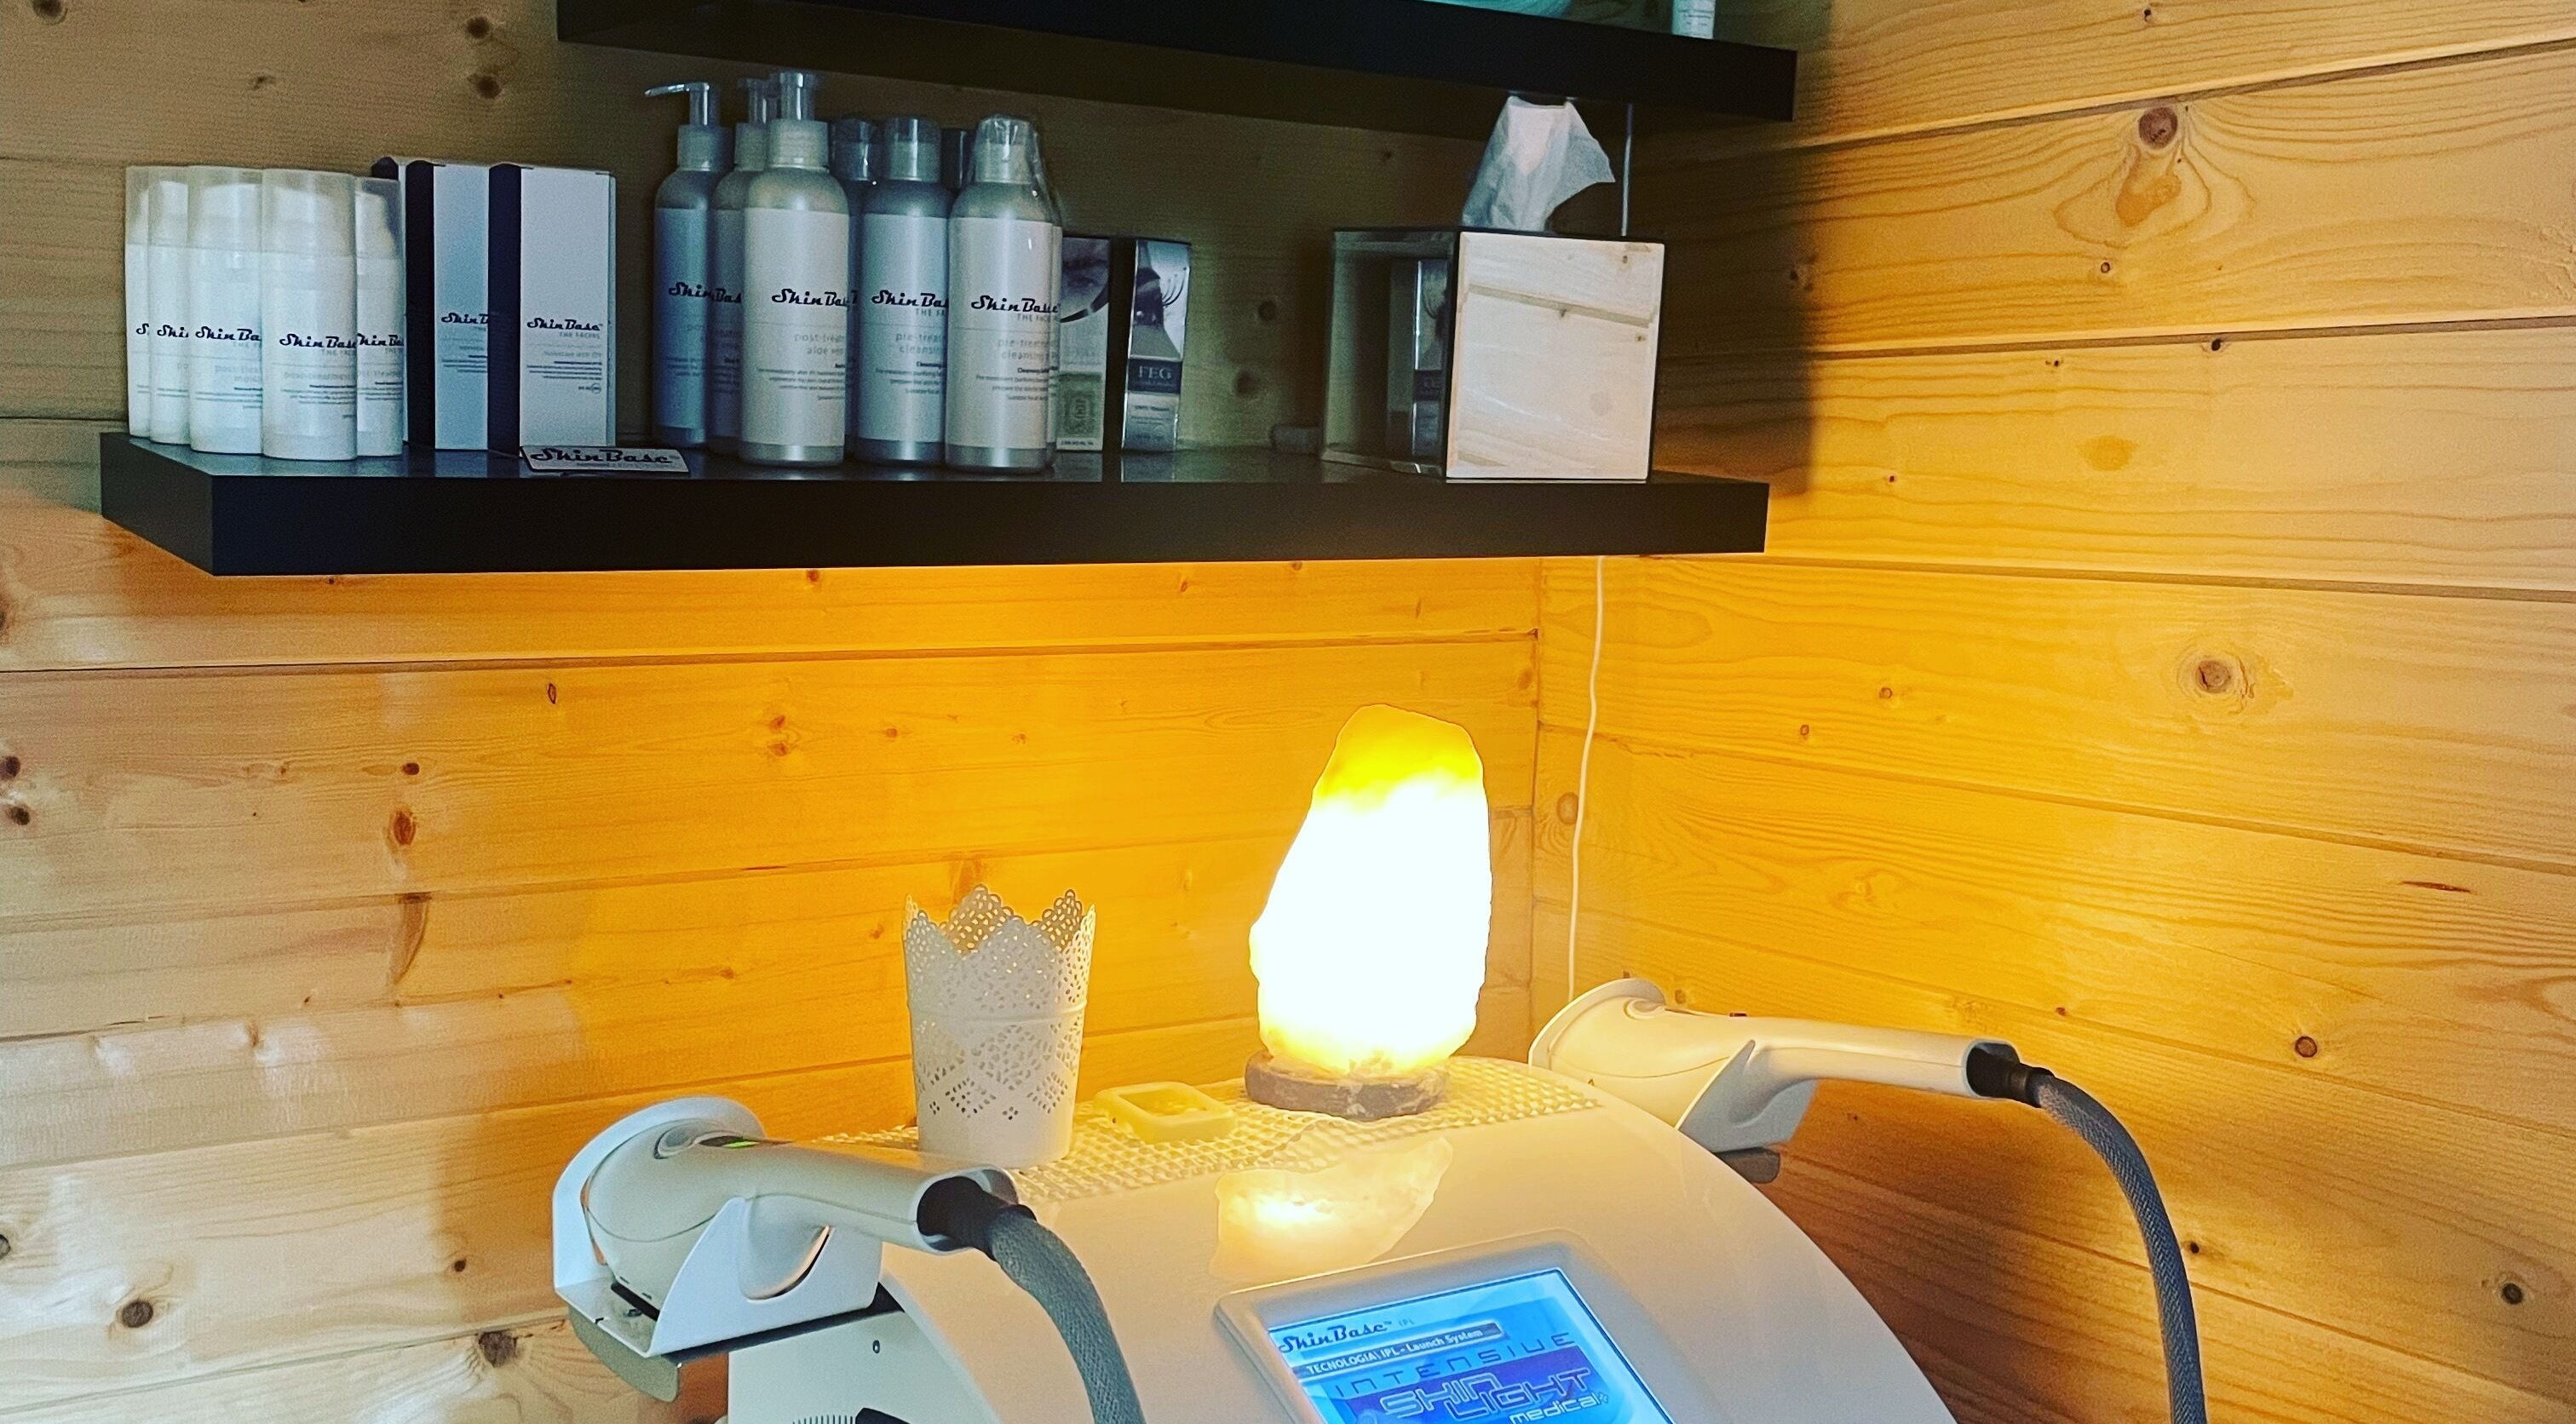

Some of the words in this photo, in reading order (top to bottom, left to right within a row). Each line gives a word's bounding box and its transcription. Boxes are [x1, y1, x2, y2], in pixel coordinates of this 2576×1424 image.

[526, 317, 601, 331] SkinBase
[1138, 365, 1173, 380] FEG
[530, 448, 673, 464] SkinBase
[1279, 1324, 1388, 1353] SkinBase
[1406, 1337, 1446, 1352] Launch
[1445, 1328, 1484, 1346] System
[1509, 1392, 1601, 1424] medical
